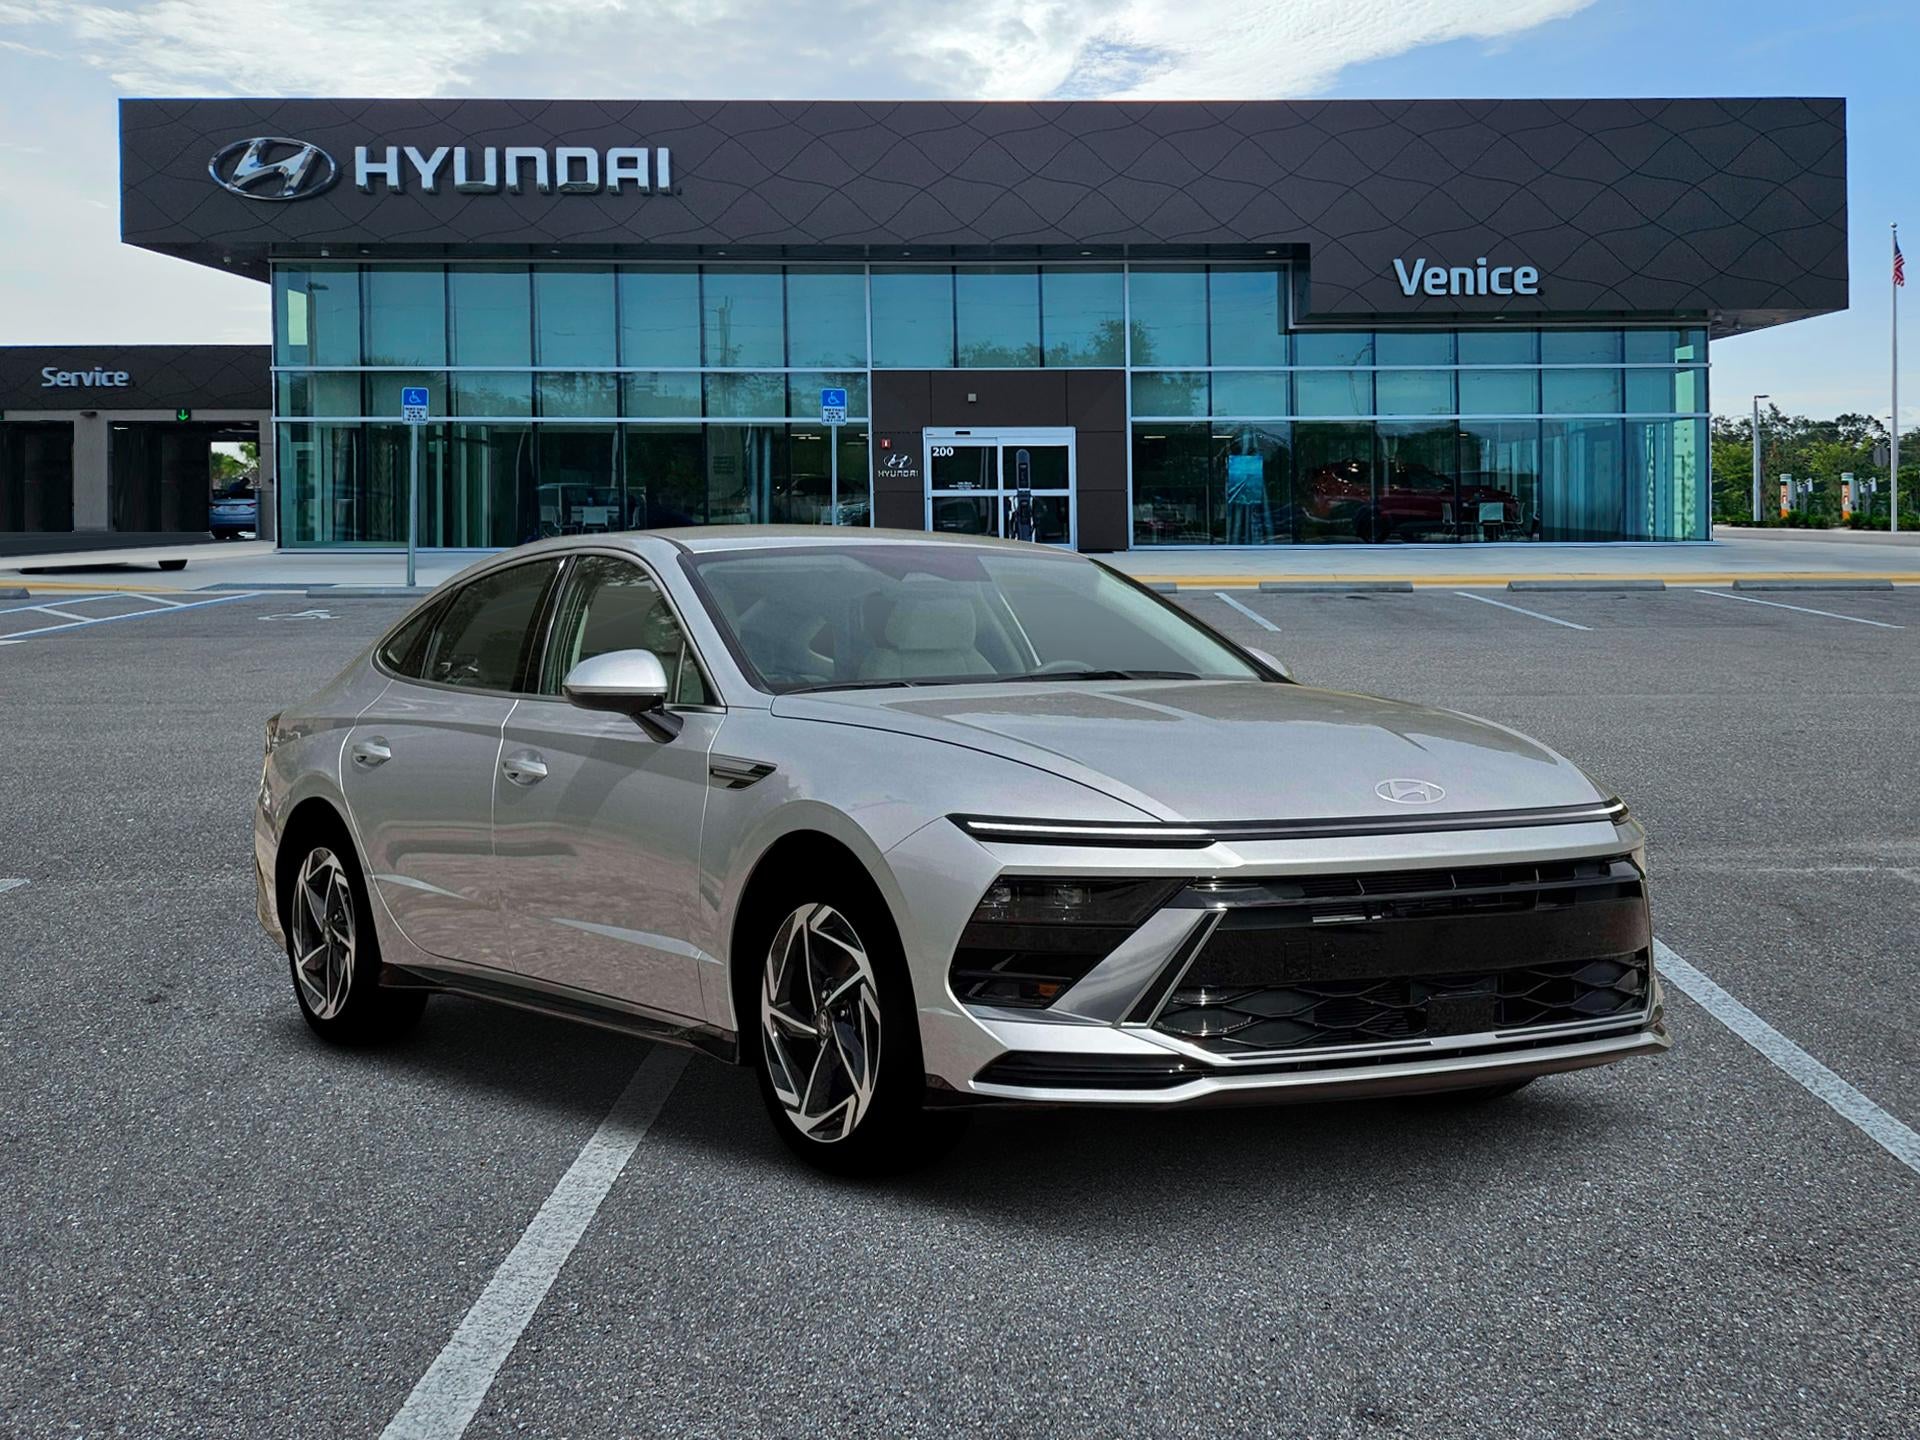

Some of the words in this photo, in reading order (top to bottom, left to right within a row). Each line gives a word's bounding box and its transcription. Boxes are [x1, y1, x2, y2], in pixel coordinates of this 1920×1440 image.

[355, 146, 670, 194] HYUNDAI
[1393, 257, 1539, 296] Venice
[41, 366, 129, 387] Service
[932, 447, 954, 457] 200
[878, 470, 919, 478] HYUNDAI
